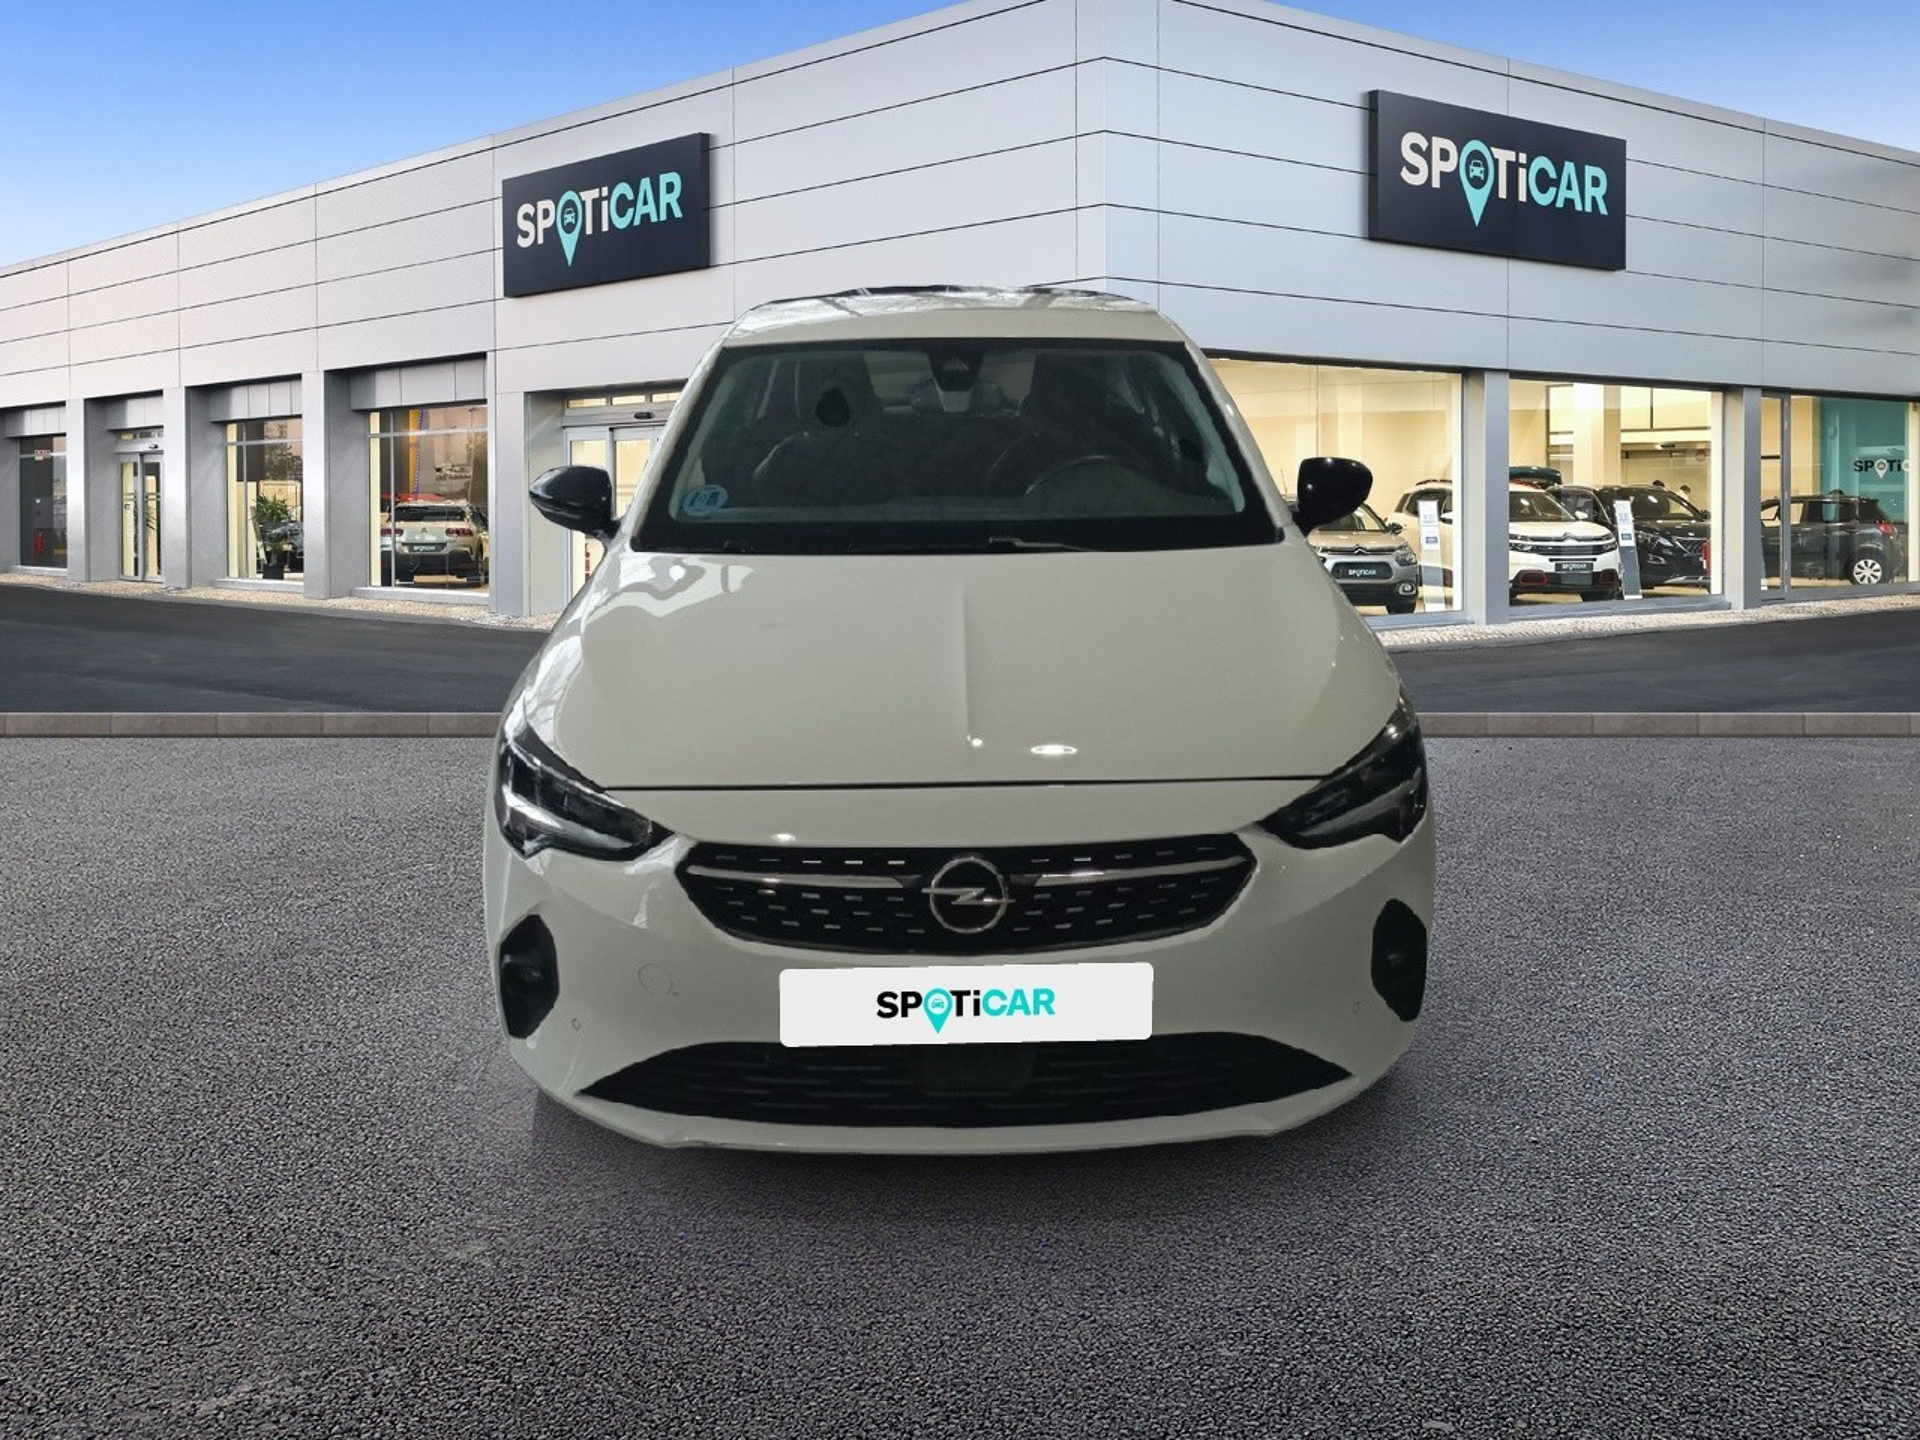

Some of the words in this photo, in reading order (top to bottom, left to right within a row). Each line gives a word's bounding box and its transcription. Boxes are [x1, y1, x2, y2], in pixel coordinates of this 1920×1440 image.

[516, 171, 683, 267] SPOTiCAR
[1400, 131, 1609, 227] SPOTiCAR
[876, 987, 1056, 1035] SPOTiCAR
